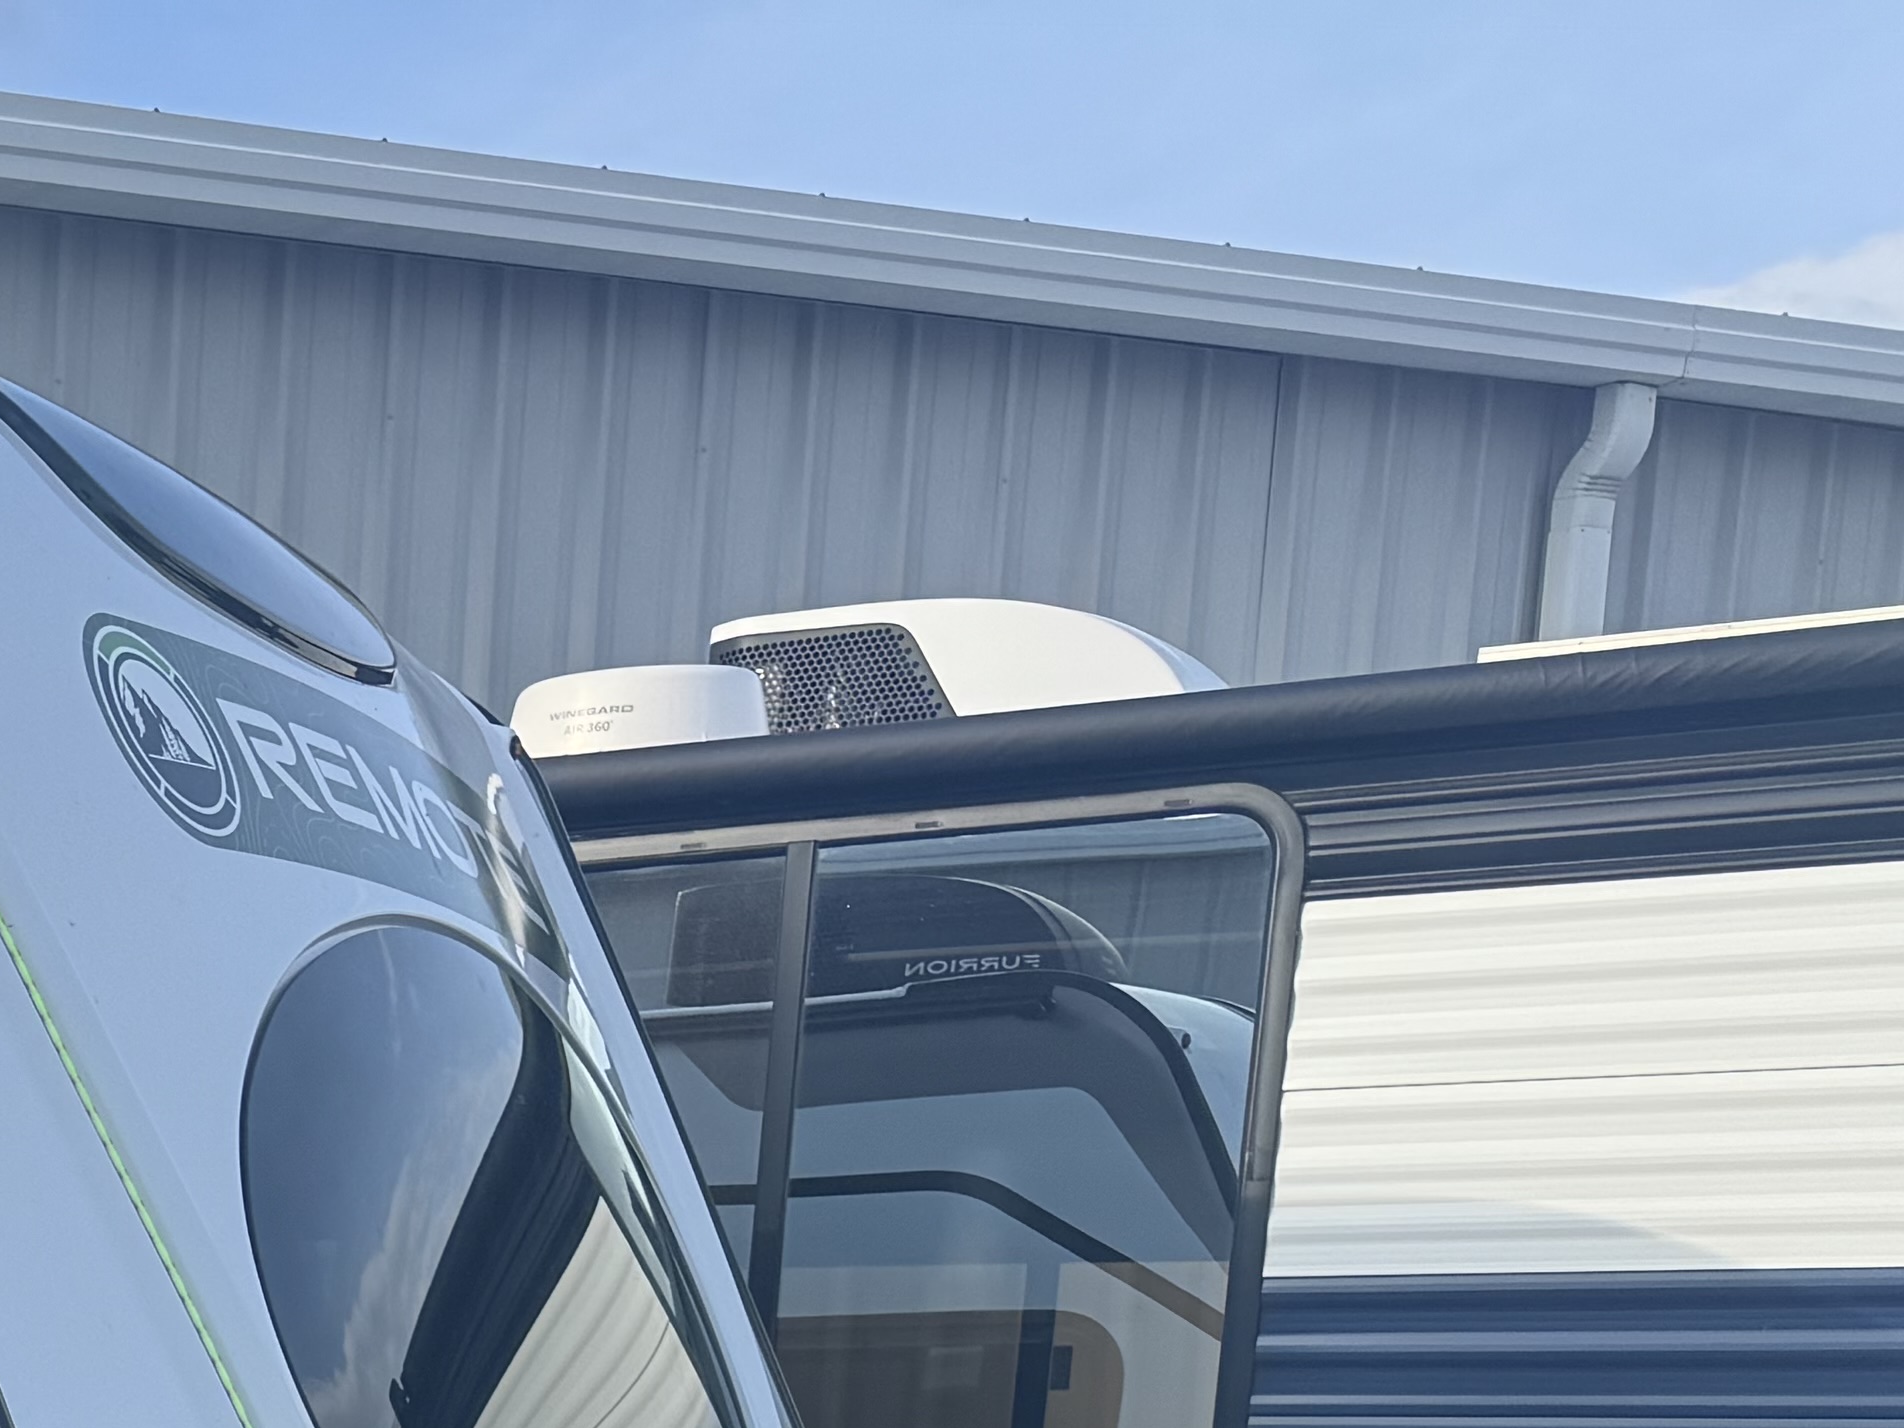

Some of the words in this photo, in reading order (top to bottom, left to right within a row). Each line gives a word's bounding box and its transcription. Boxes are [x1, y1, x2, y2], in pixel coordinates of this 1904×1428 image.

[549, 704, 635, 721] WINEGARD
[564, 724, 585, 736] AIR
[216, 697, 550, 936] REMOTE
